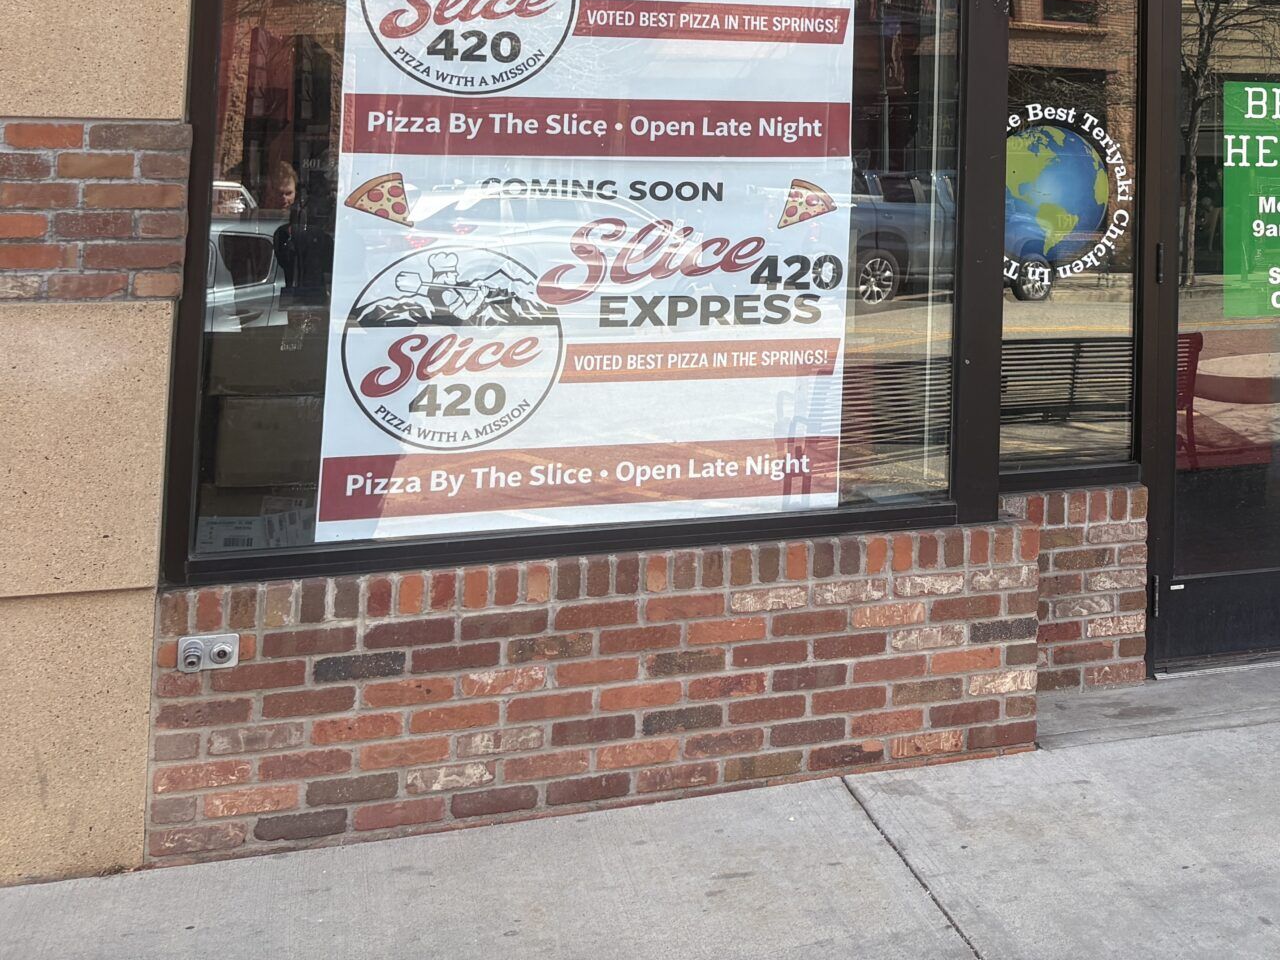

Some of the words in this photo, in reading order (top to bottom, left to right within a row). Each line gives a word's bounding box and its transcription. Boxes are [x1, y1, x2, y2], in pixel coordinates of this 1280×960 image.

[586, 9, 635, 27] VOTED
[638, 11, 676, 28] BEST
[680, 13, 720, 30] PIZZA
[724, 14, 738, 31] IN
[742, 15, 769, 32] THE
[772, 16, 839, 34] SPRINGS!
[426, 29, 522, 64] 420
[393, 46, 432, 79] PIZZA
[435, 70, 475, 88] WITH
[479, 75, 489, 88] A
[491, 48, 546, 85] MISSION
[368, 111, 441, 133] Pizza
[449, 113, 483, 138] By
[489, 113, 539, 135] The
[546, 113, 608, 136] Slice
[631, 116, 695, 144] Open
[702, 117, 751, 138] Late
[758, 117, 822, 142] Night
[1025, 103, 1077, 124] Best
[1081, 113, 1134, 202] Teriyaki
[482, 177, 617, 201] COMING
[629, 180, 724, 201] SOON
[535, 217, 766, 305] Slice
[750, 254, 843, 290] 420
[1057, 208, 1129, 279] Chicken
[1027, 267, 1051, 285] In
[599, 294, 822, 328] EXPRESS
[360, 333, 542, 398] Slice
[573, 354, 623, 372] VOTED
[626, 352, 664, 370] BEST
[668, 351, 709, 368] PIZZA
[713, 350, 728, 367] IN
[731, 349, 758, 366] THE
[761, 348, 828, 366] SPRINGS!
[408, 382, 507, 417] 420
[374, 404, 413, 435] PIZZA
[417, 426, 457, 443] WITH
[461, 429, 473, 441] A
[474, 398, 531, 441] MISSION
[345, 470, 421, 497] Pizza
[429, 469, 465, 496] By
[471, 466, 521, 490] The
[528, 463, 592, 488] Slice
[616, 459, 681, 487] Open
[688, 457, 738, 479] Late
[745, 453, 811, 480] Night
